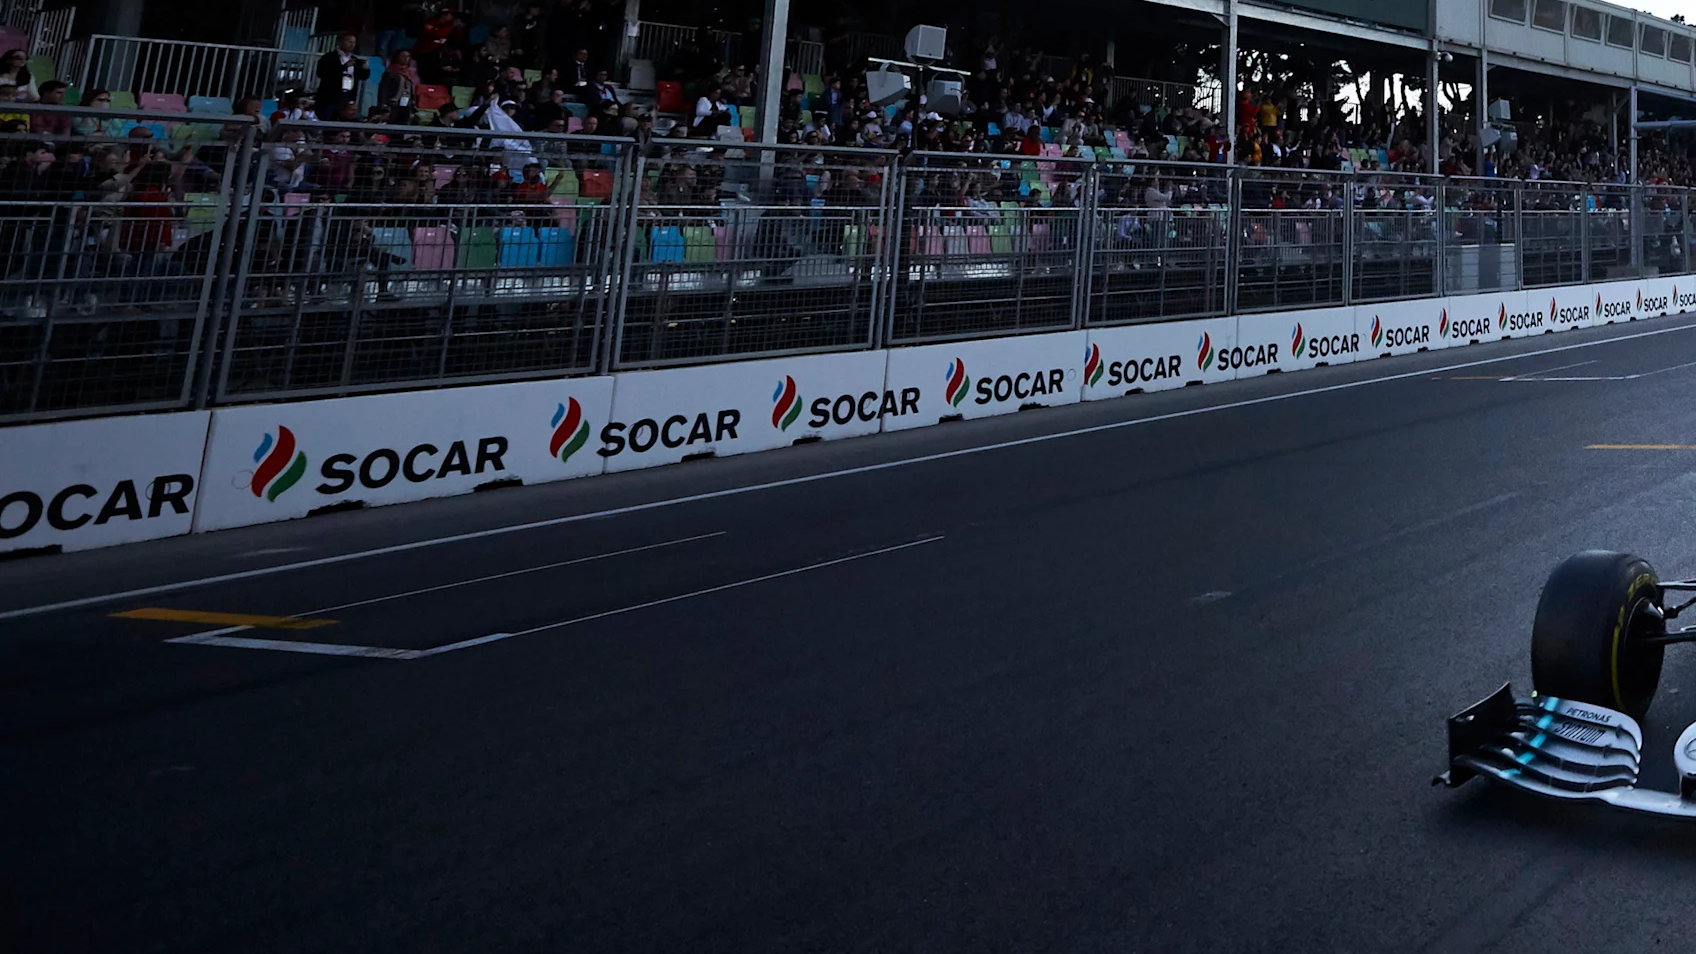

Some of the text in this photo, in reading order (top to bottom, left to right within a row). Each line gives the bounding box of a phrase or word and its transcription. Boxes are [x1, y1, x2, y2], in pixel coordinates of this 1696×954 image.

[315, 435, 509, 495] SOCAR
[596, 408, 741, 457] SOCAR
[808, 387, 920, 428] SOCAR
[974, 368, 1064, 405] SOCAR
[1108, 355, 1181, 386] SOCAR
[1217, 343, 1278, 371] SOCAR
[1308, 333, 1360, 358] SOCAR
[1385, 325, 1430, 348] SOCAR
[1452, 317, 1490, 339] SOCAR
[1509, 311, 1543, 331] SOCAR
[1559, 306, 1590, 324] SOCAR
[1604, 301, 1631, 318] SOCAR
[1643, 296, 1668, 312] SOCAR
[1566, 707, 1612, 723] PETRONAS
